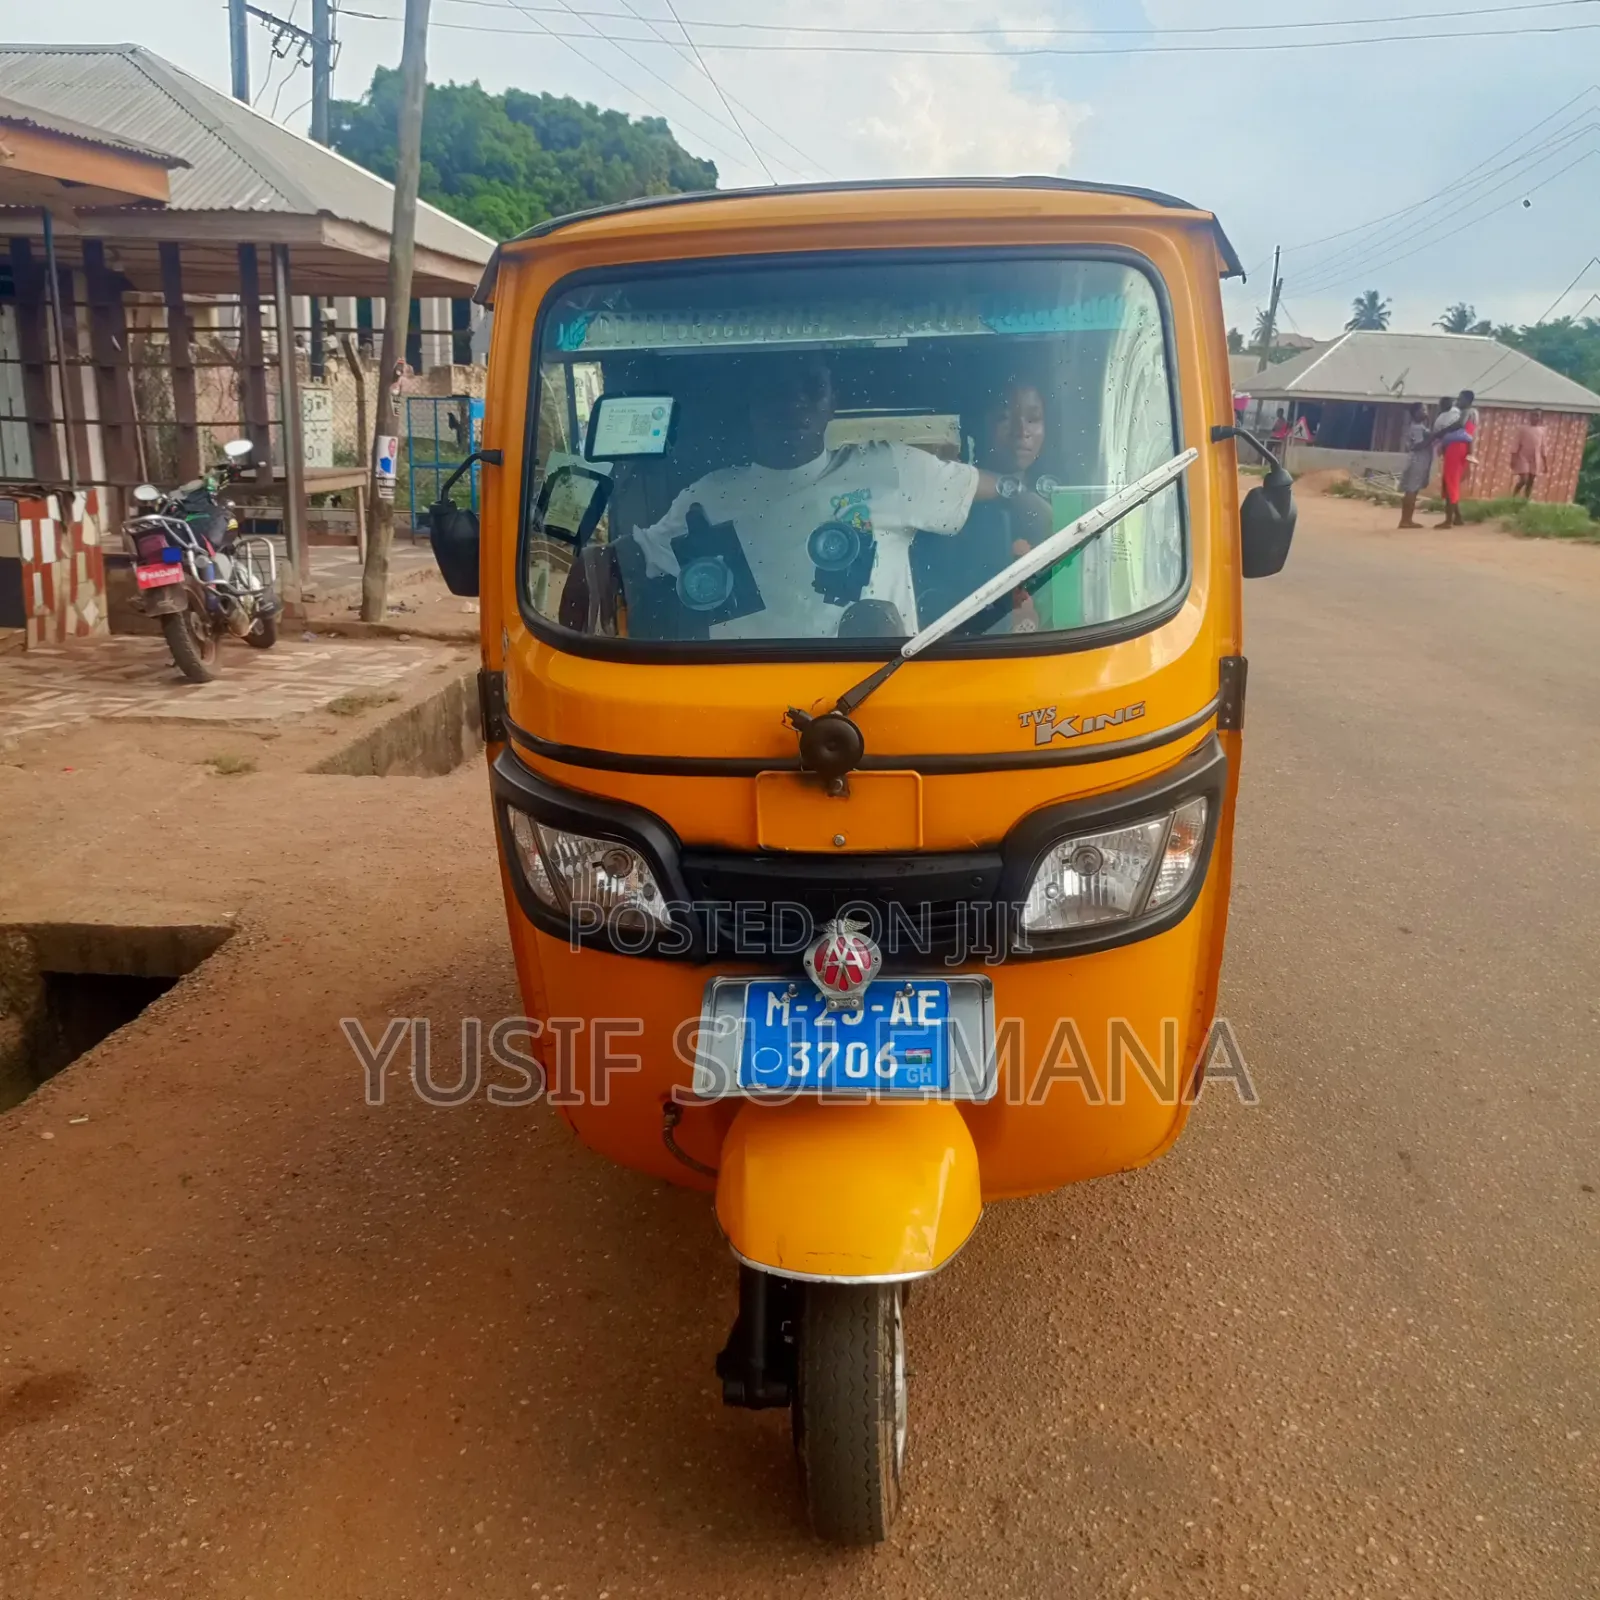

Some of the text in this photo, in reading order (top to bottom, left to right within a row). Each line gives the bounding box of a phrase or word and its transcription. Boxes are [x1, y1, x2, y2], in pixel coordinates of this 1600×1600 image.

[1018, 706, 1057, 728] TVS
[1035, 701, 1146, 746] KING
[787, 1042, 898, 1079] 3706
[906, 1067, 932, 1083] GH
